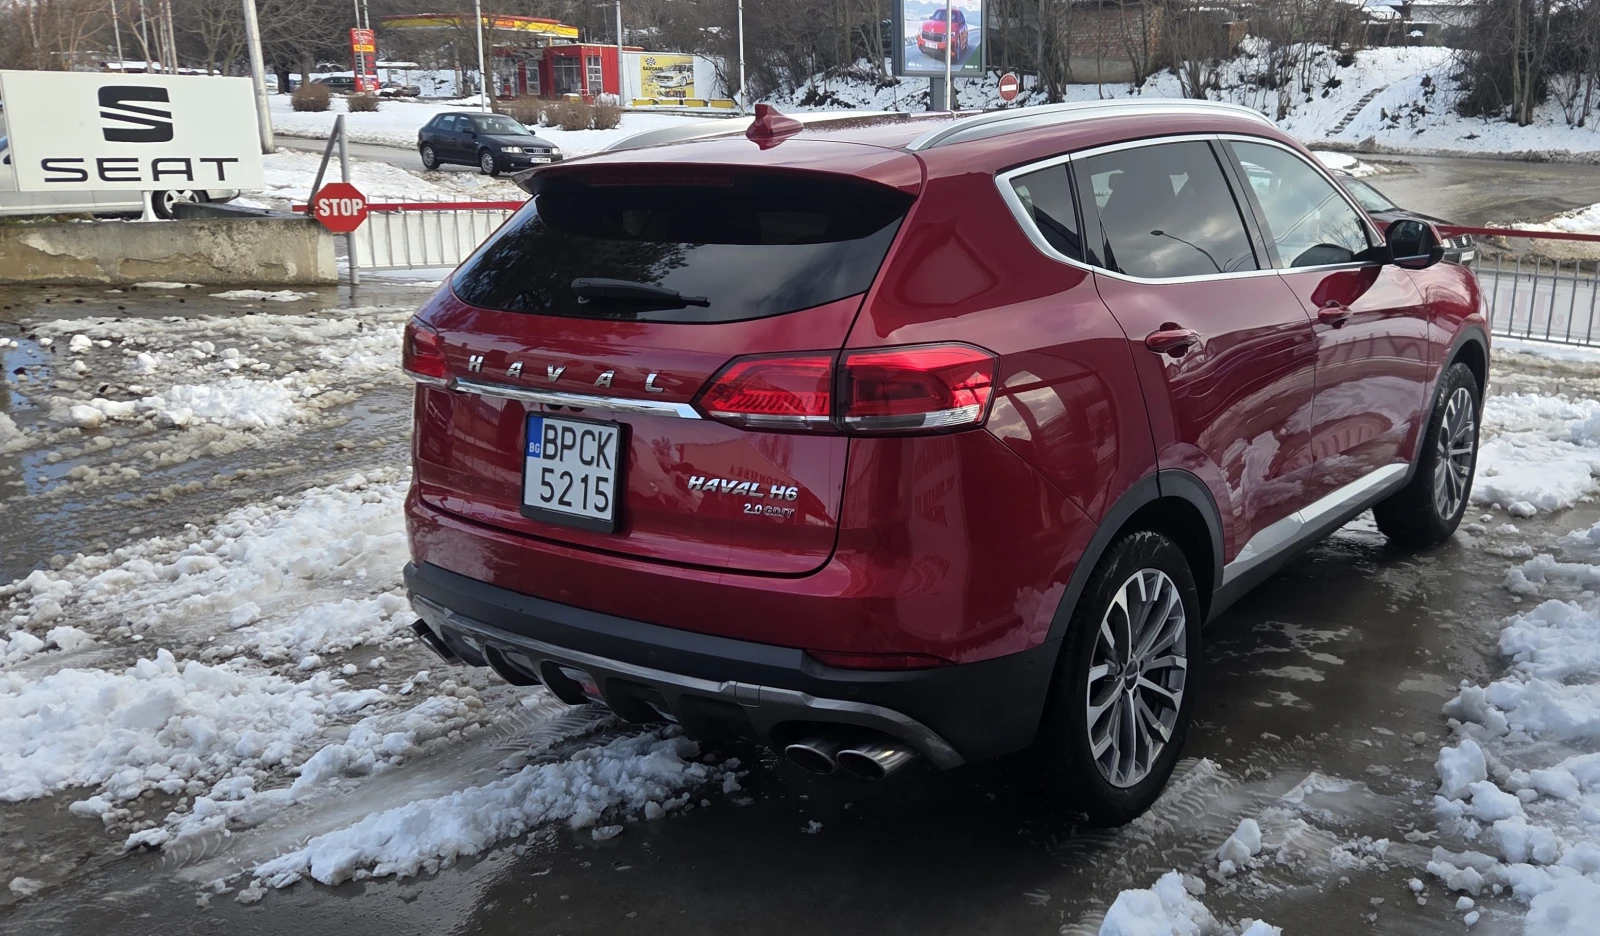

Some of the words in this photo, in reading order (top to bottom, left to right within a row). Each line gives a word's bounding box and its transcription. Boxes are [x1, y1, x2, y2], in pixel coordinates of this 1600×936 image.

[40, 157, 239, 183] SEAT
[318, 197, 364, 217] STOP
[468, 354, 664, 393] HAVAL
[529, 442, 541, 454] BG
[542, 423, 614, 470] BPCK
[540, 467, 609, 513] 5215
[687, 475, 765, 498] HAVAL
[769, 484, 798, 501] H6
[743, 503, 763, 515] 2.0
